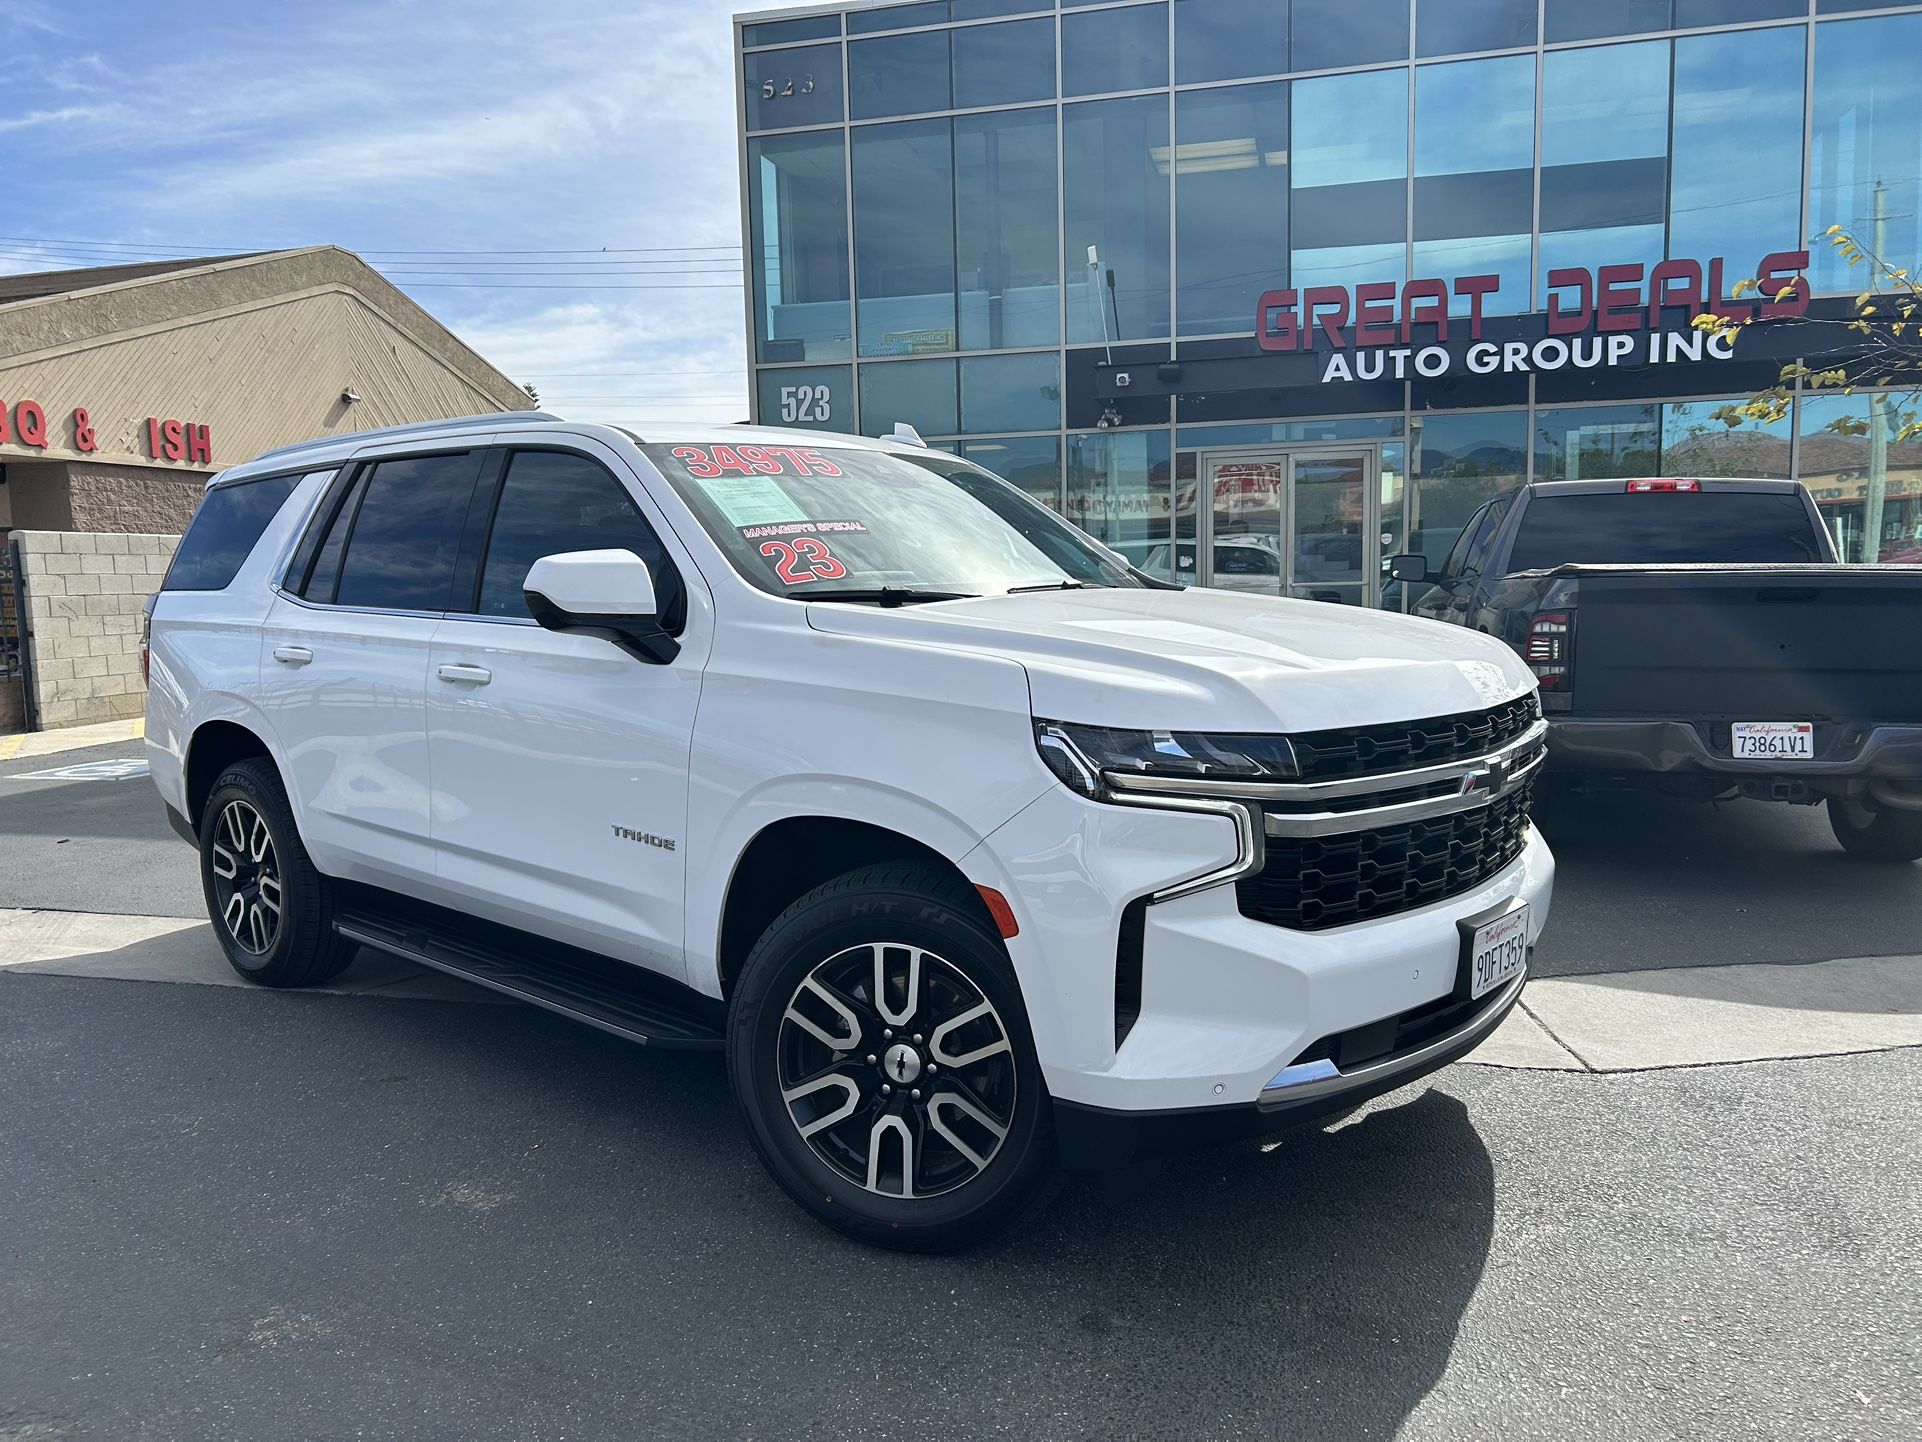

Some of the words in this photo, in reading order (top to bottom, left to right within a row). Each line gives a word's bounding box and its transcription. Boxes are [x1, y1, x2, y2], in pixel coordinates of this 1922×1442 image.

[762, 73, 814, 98] 523
[1256, 273, 1500, 352] GREAT
[1547, 250, 1811, 335] DEALS
[1321, 346, 1450, 384] AUTO
[1466, 333, 1635, 374] GROUP
[1649, 327, 1734, 363] INC
[780, 384, 831, 422] 523
[75, 407, 99, 452] &
[147, 417, 212, 463] ISH
[672, 445, 843, 478] 34975
[743, 523, 816, 539] MANAGER'S
[816, 522, 867, 532] SPECIAL
[760, 537, 847, 585] 23
[1737, 735, 1808, 753] 73861V1
[1748, 724, 1794, 736] California
[219, 774, 257, 795] CELIMO
[611, 824, 676, 852] TAHOE
[1485, 920, 1519, 945] California
[1476, 932, 1524, 988] 9DFT359
